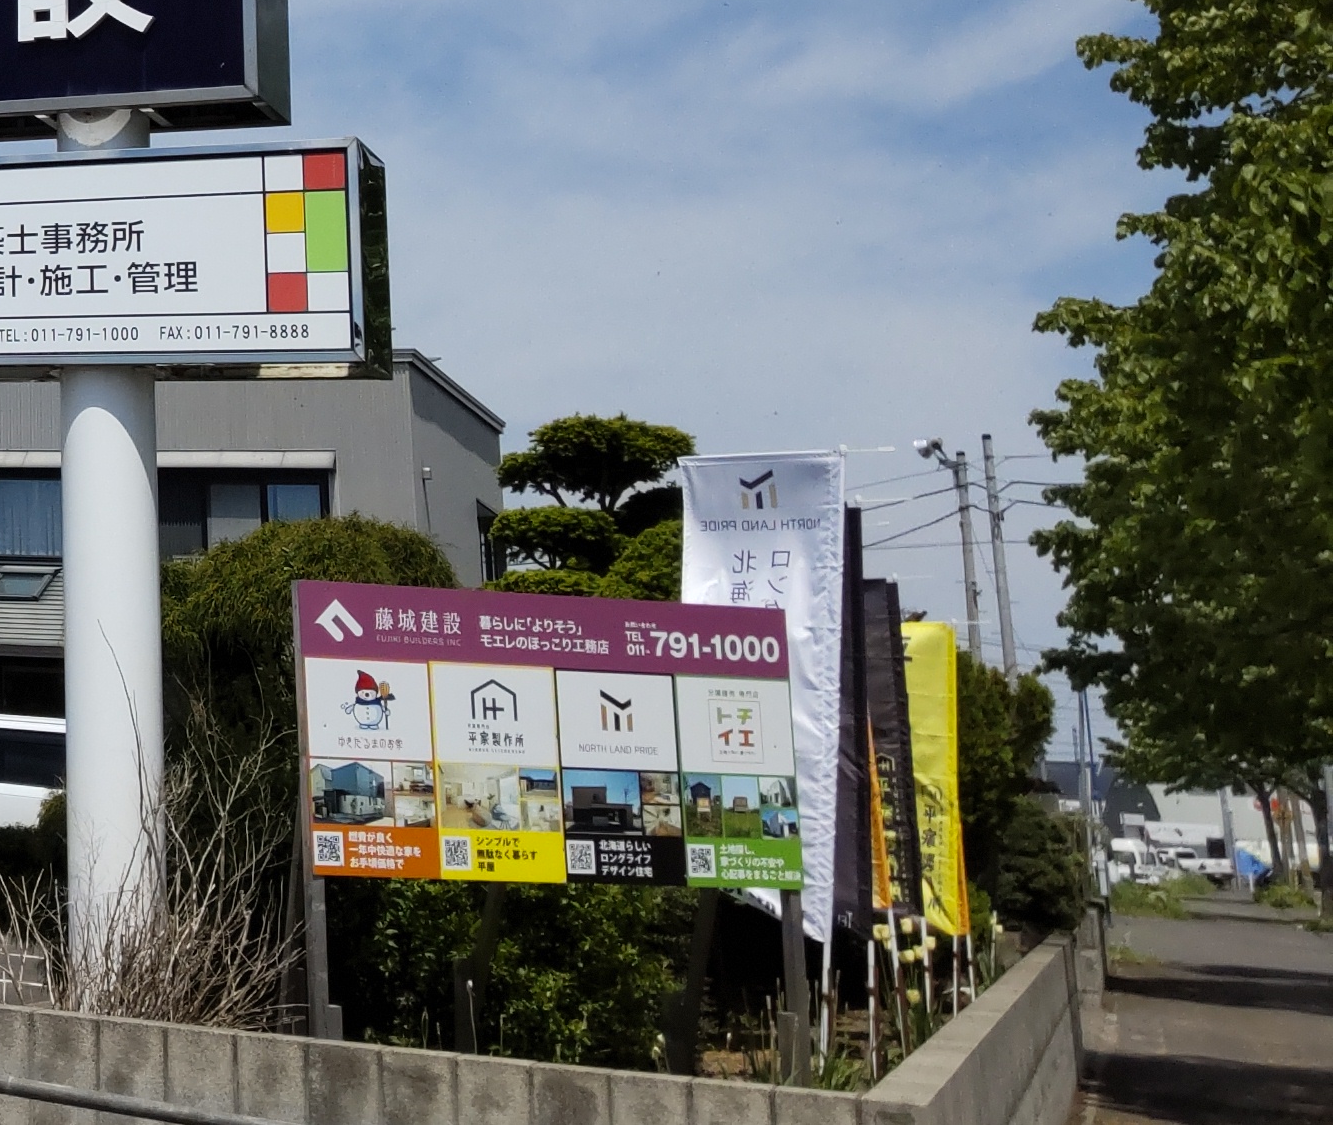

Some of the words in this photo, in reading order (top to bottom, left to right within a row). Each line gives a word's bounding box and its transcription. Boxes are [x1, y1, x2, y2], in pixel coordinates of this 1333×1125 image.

[375, 607, 462, 635] 藤城建設
[625, 631, 644, 642] TEL
[480, 634, 609, 655] モエレのほっこり工務店
[650, 631, 779, 662] 791-1000
[579, 744, 607, 754] NORTH
[610, 745, 631, 755] LAND
[635, 746, 659, 756] PRIDE
[476, 836, 520, 847] シンプルで
[599, 840, 652, 851] 北海道らしい
[477, 849, 538, 861] 無駄なく暮らす
[600, 854, 652, 865] ロングライフ
[477, 862, 495, 872] 平屋
[601, 865, 653, 878] デザイン住宅
